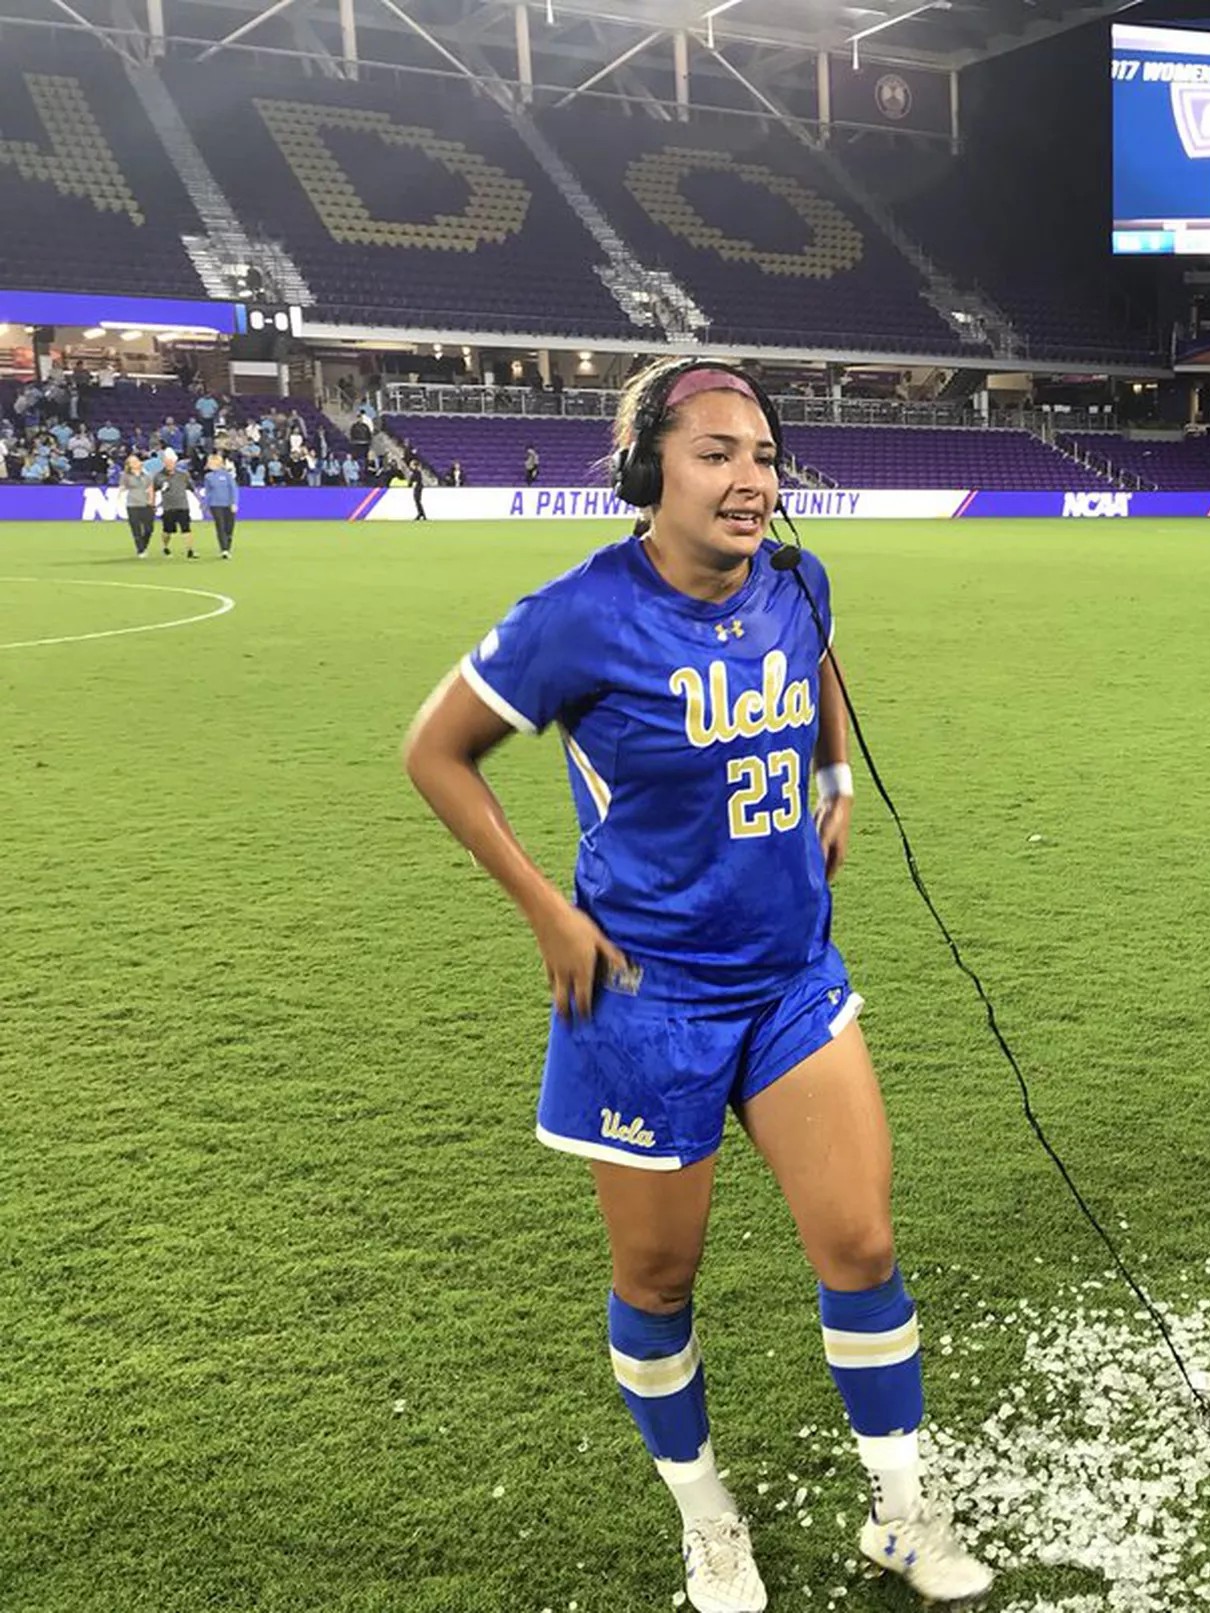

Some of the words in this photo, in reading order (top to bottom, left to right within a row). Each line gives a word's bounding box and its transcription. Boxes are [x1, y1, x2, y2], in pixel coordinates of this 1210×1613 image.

[510, 491, 523, 514] A
[1062, 491, 1132, 517] NCAA
[669, 650, 815, 748] Ucla
[727, 748, 801, 839] 23
[600, 1107, 656, 1148] Ucla
